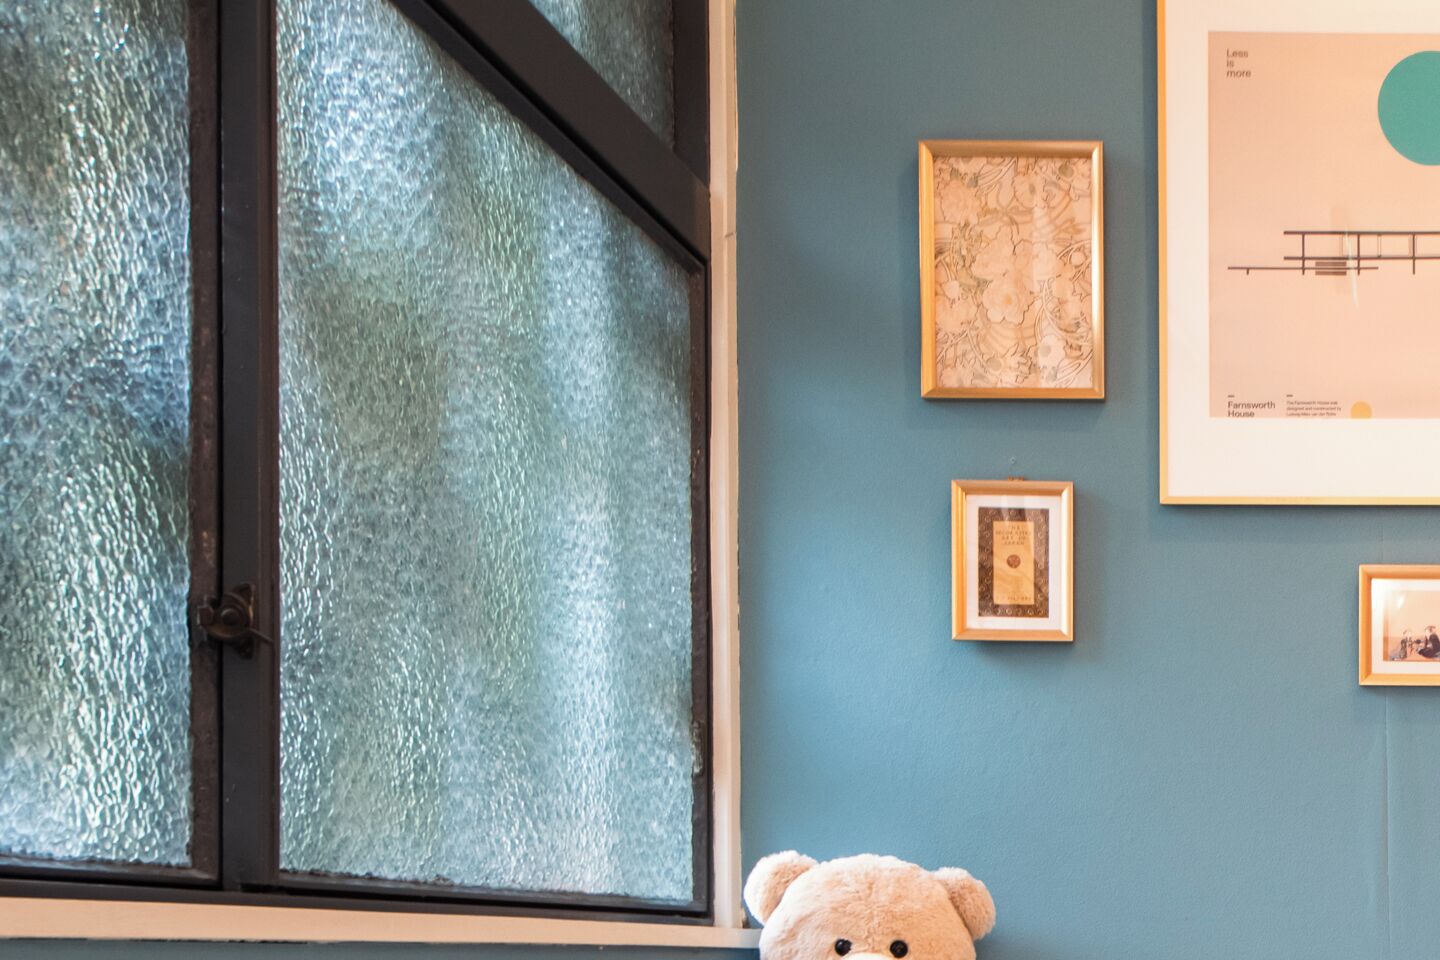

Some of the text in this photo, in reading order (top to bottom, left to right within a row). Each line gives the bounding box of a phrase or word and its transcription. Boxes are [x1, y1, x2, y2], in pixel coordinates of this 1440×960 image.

[1226, 48, 1249, 58] Less
[1226, 59, 1235, 68] is
[1226, 70, 1252, 78] more
[1227, 401, 1276, 410] Farnsworth
[1227, 410, 1255, 418] House
